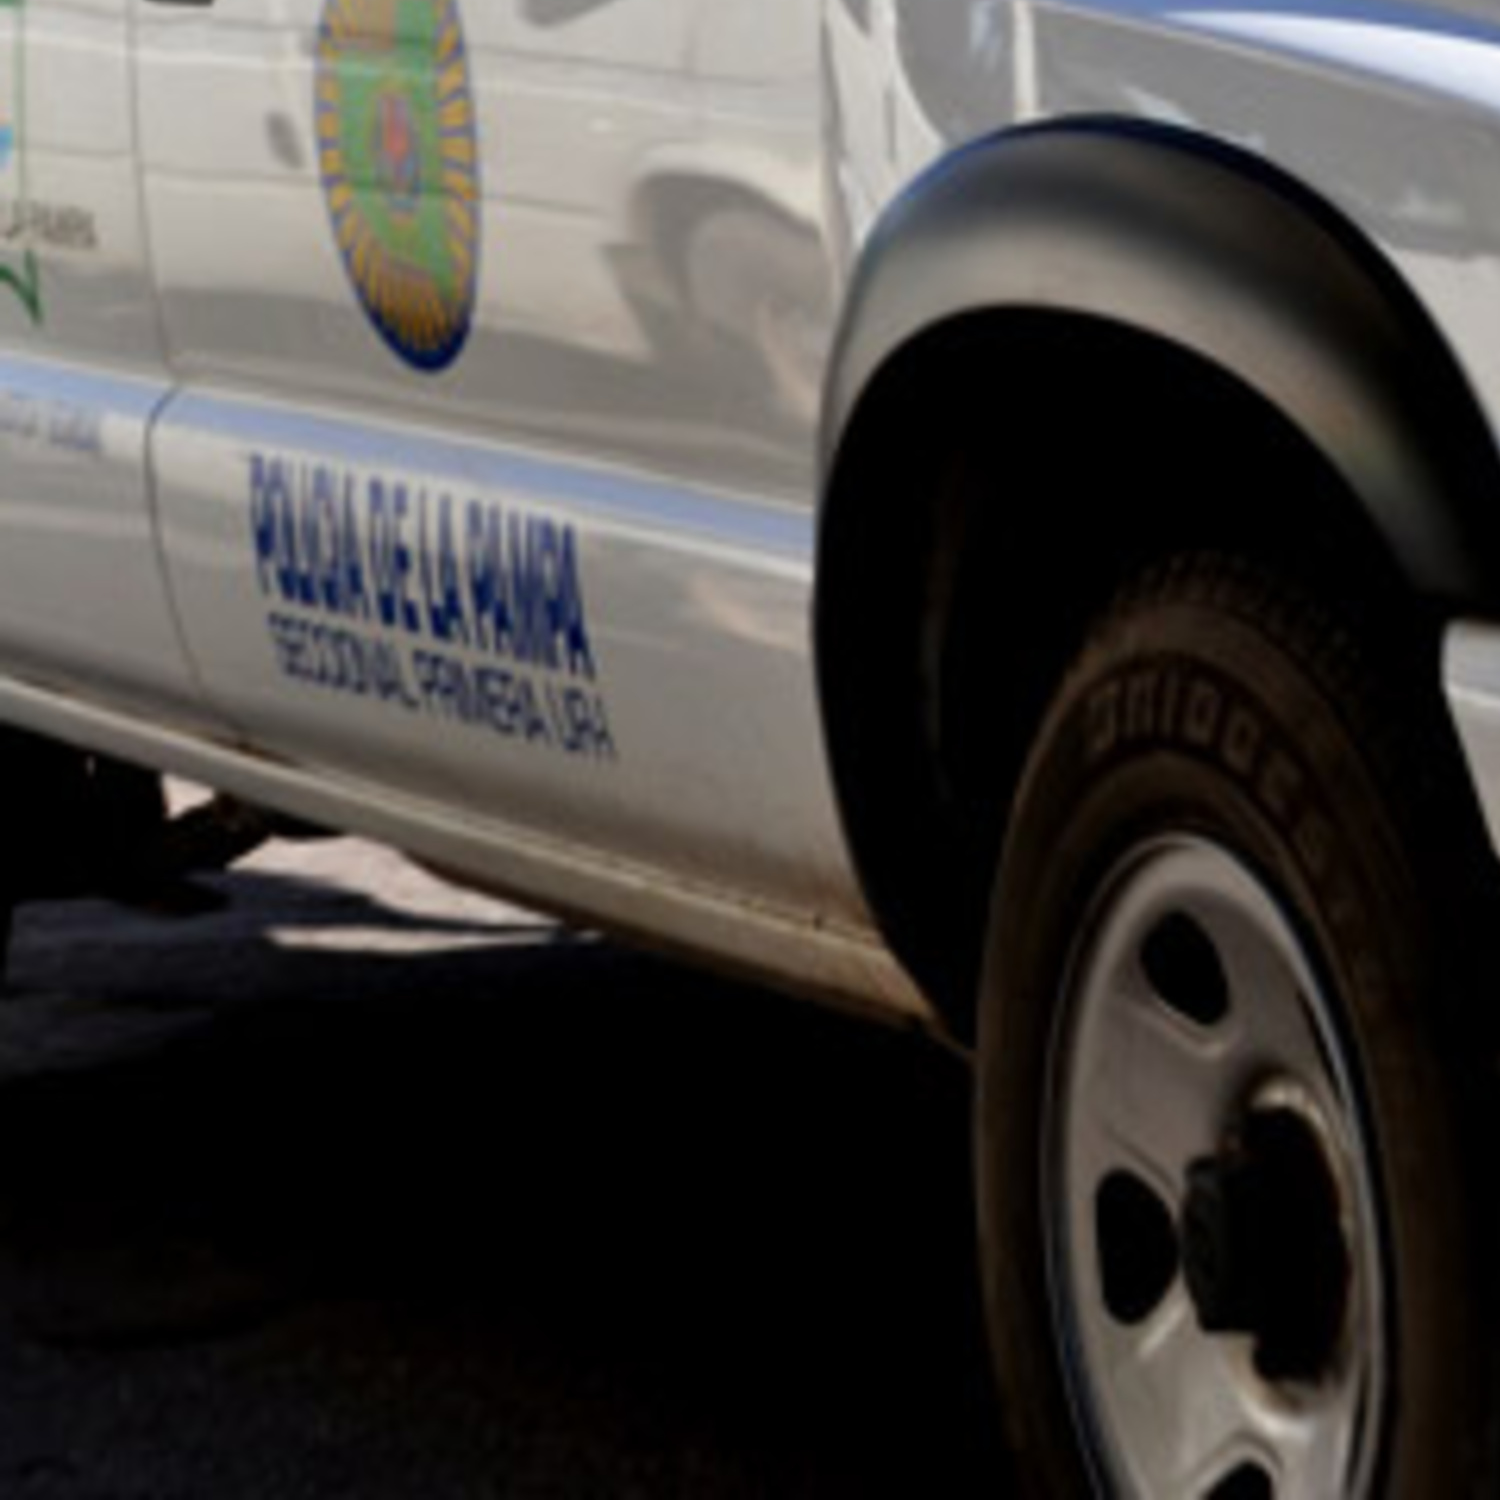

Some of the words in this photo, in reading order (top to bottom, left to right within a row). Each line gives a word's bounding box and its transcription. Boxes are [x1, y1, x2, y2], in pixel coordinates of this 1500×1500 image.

[250, 453, 370, 623] POLICIA
[369, 476, 421, 634] DE
[419, 487, 471, 647] LA
[466, 498, 597, 684] PAMPA
